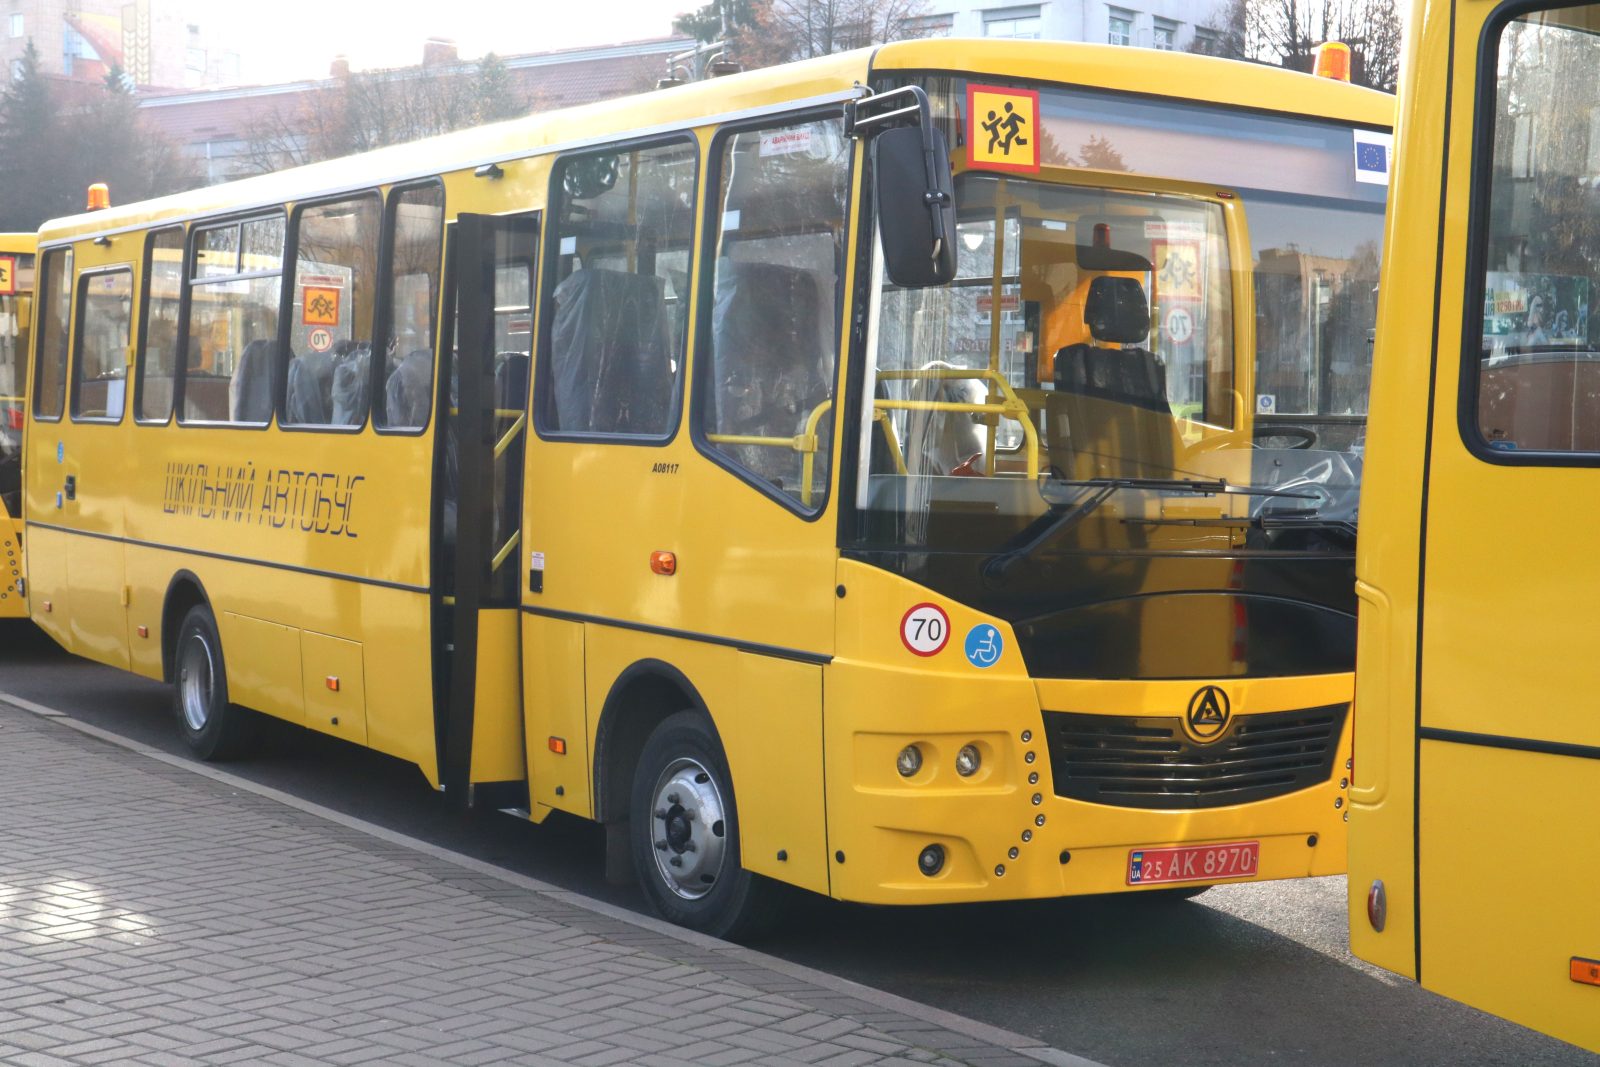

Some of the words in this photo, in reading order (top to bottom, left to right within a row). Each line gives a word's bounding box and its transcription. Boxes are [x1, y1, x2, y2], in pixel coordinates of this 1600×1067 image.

[652, 463, 680, 475] A08117
[163, 461, 256, 524] ШКІЛЬНИЙ
[259, 469, 366, 538] АВТОБУС
[912, 618, 941, 641] 70
[1131, 869, 1141, 879] UA
[1143, 861, 1162, 879] 25
[1168, 852, 1198, 877] AK
[1204, 848, 1252, 874] 8970
